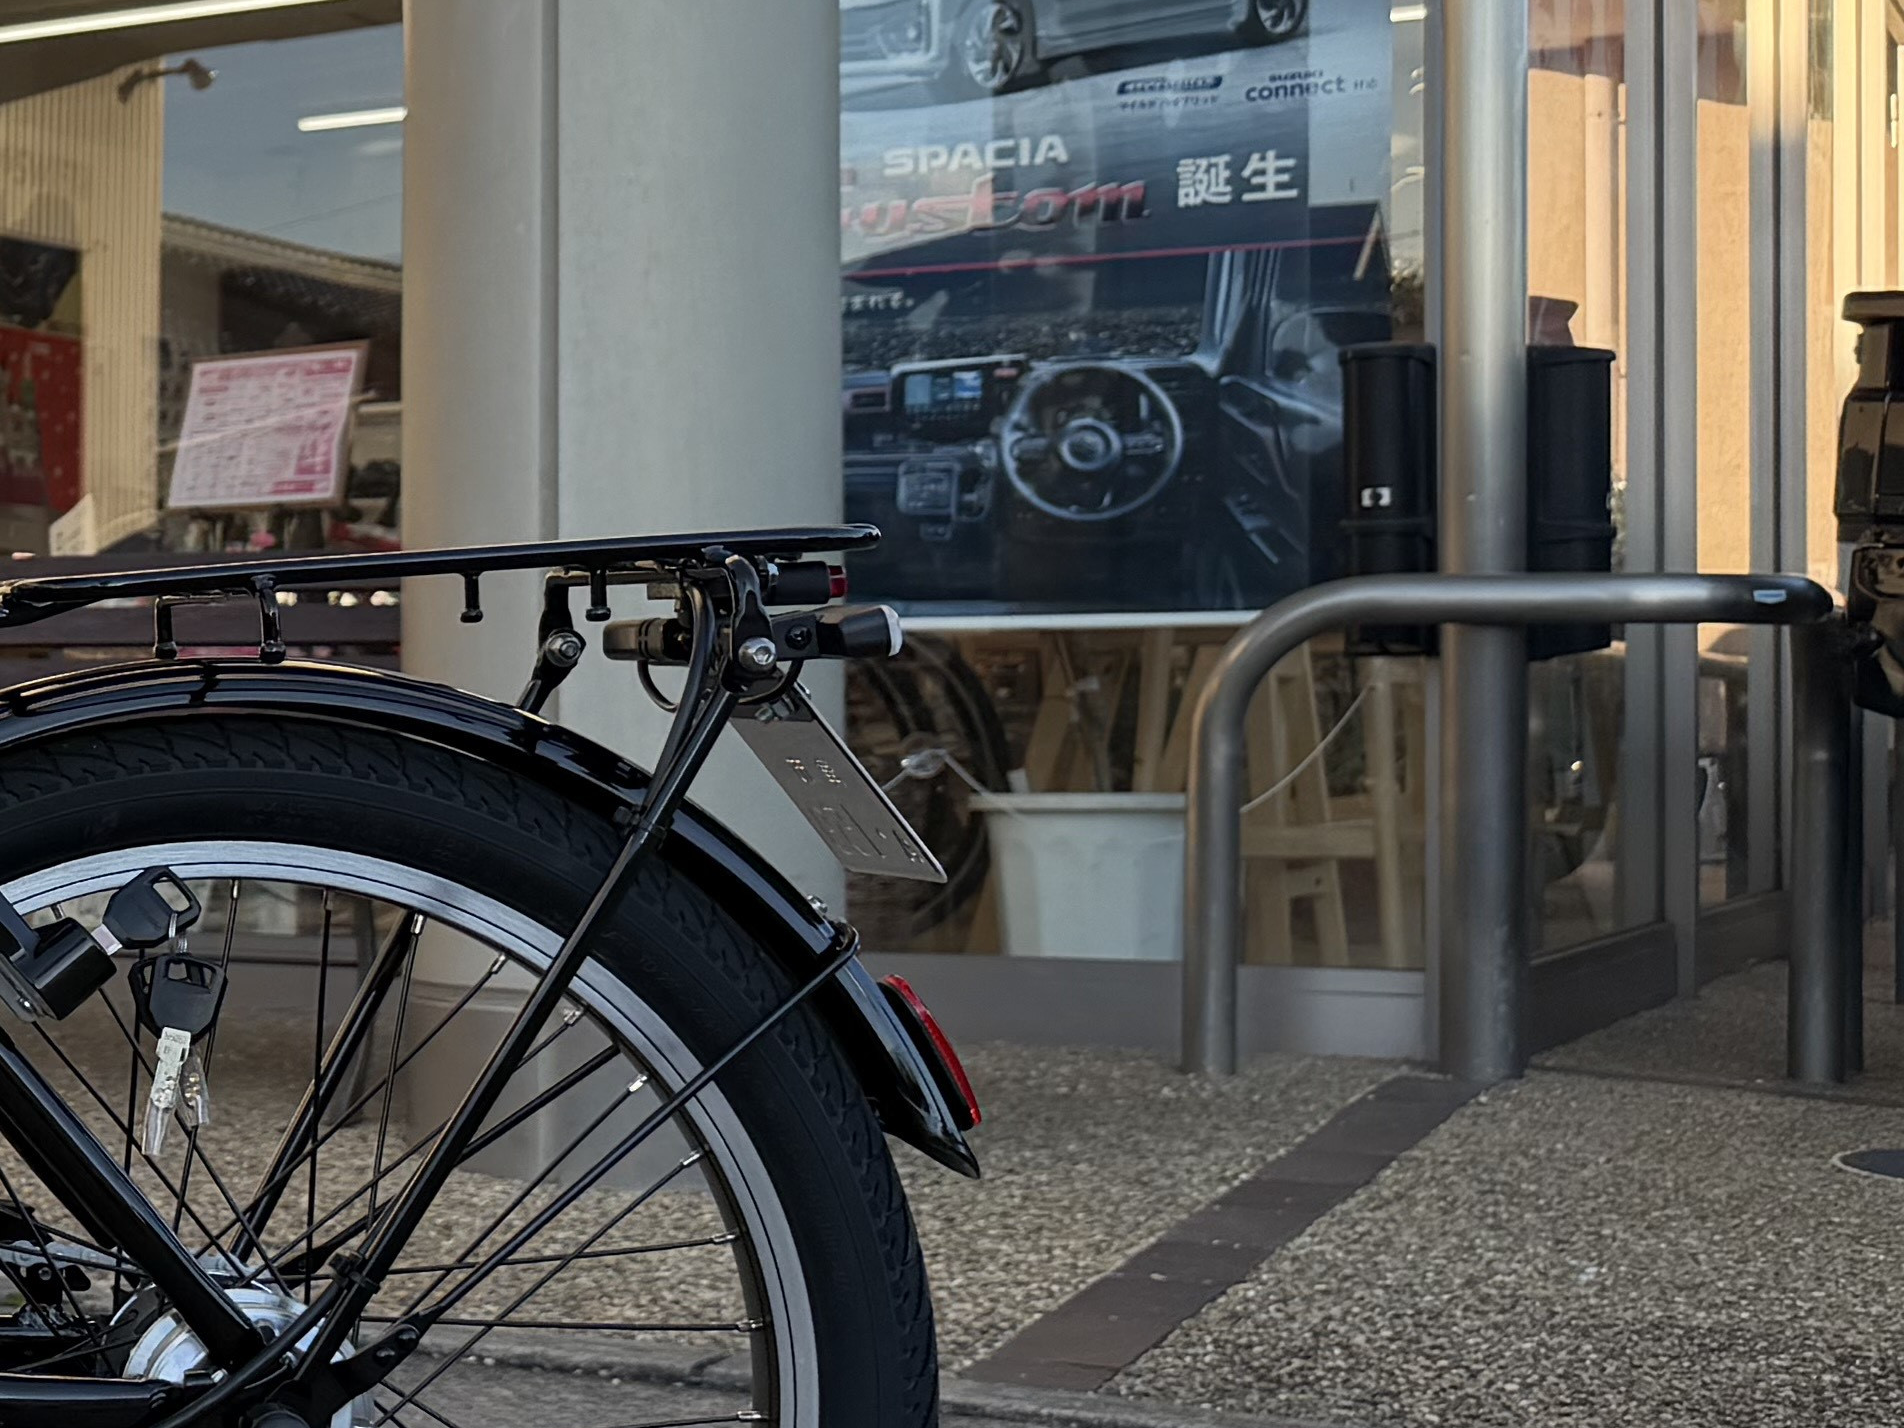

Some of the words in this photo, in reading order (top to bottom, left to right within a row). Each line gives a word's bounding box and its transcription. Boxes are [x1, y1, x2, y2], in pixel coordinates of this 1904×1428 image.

[1245, 76, 1345, 102] connect
[883, 135, 1070, 175] SPACIA
[841, 173, 1152, 239] ustom
[1176, 149, 1299, 207] 誕生
